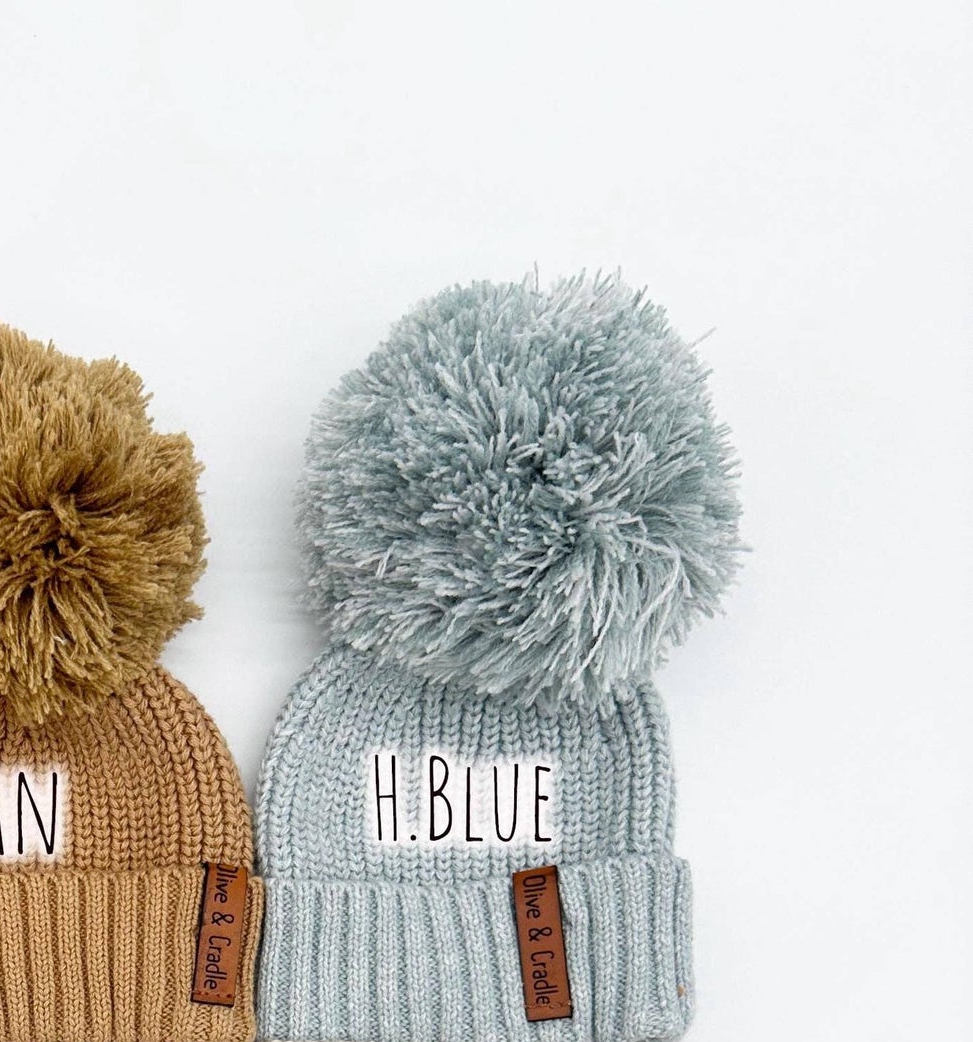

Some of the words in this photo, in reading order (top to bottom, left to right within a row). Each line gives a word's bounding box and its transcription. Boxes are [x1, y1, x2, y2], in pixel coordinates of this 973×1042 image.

[213, 864, 238, 904] Olive
[522, 874, 546, 919] Olive
[211, 911, 235, 926] &
[528, 926, 553, 942] &
[203, 935, 231, 990] Cradle
[530, 950, 559, 1005] Cradle
